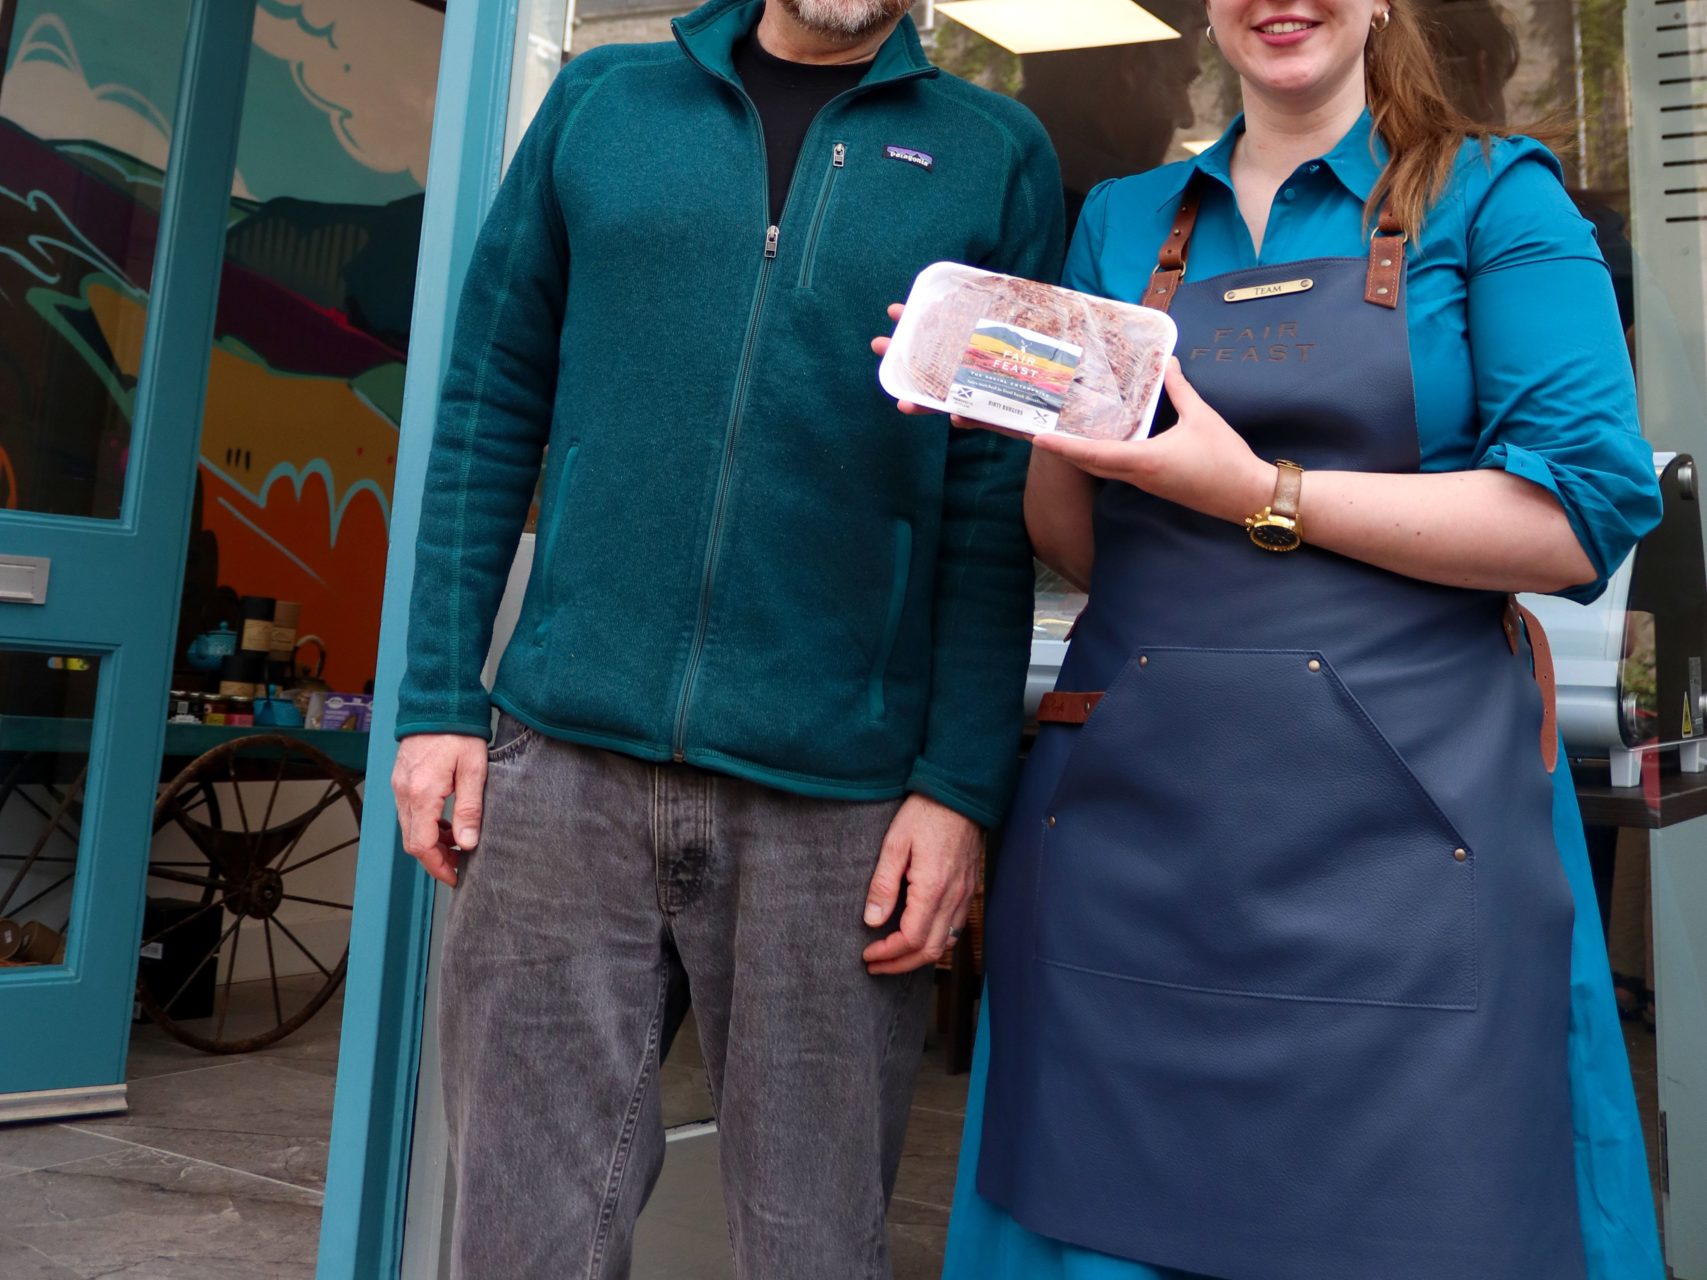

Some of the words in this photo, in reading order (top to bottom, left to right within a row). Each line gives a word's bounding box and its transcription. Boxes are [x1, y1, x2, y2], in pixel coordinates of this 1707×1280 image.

[1214, 321, 1298, 344] FAIR
[1002, 350, 1036, 366] FAIR
[1190, 343, 1316, 363] FEAST
[993, 359, 1039, 378] FEAST
